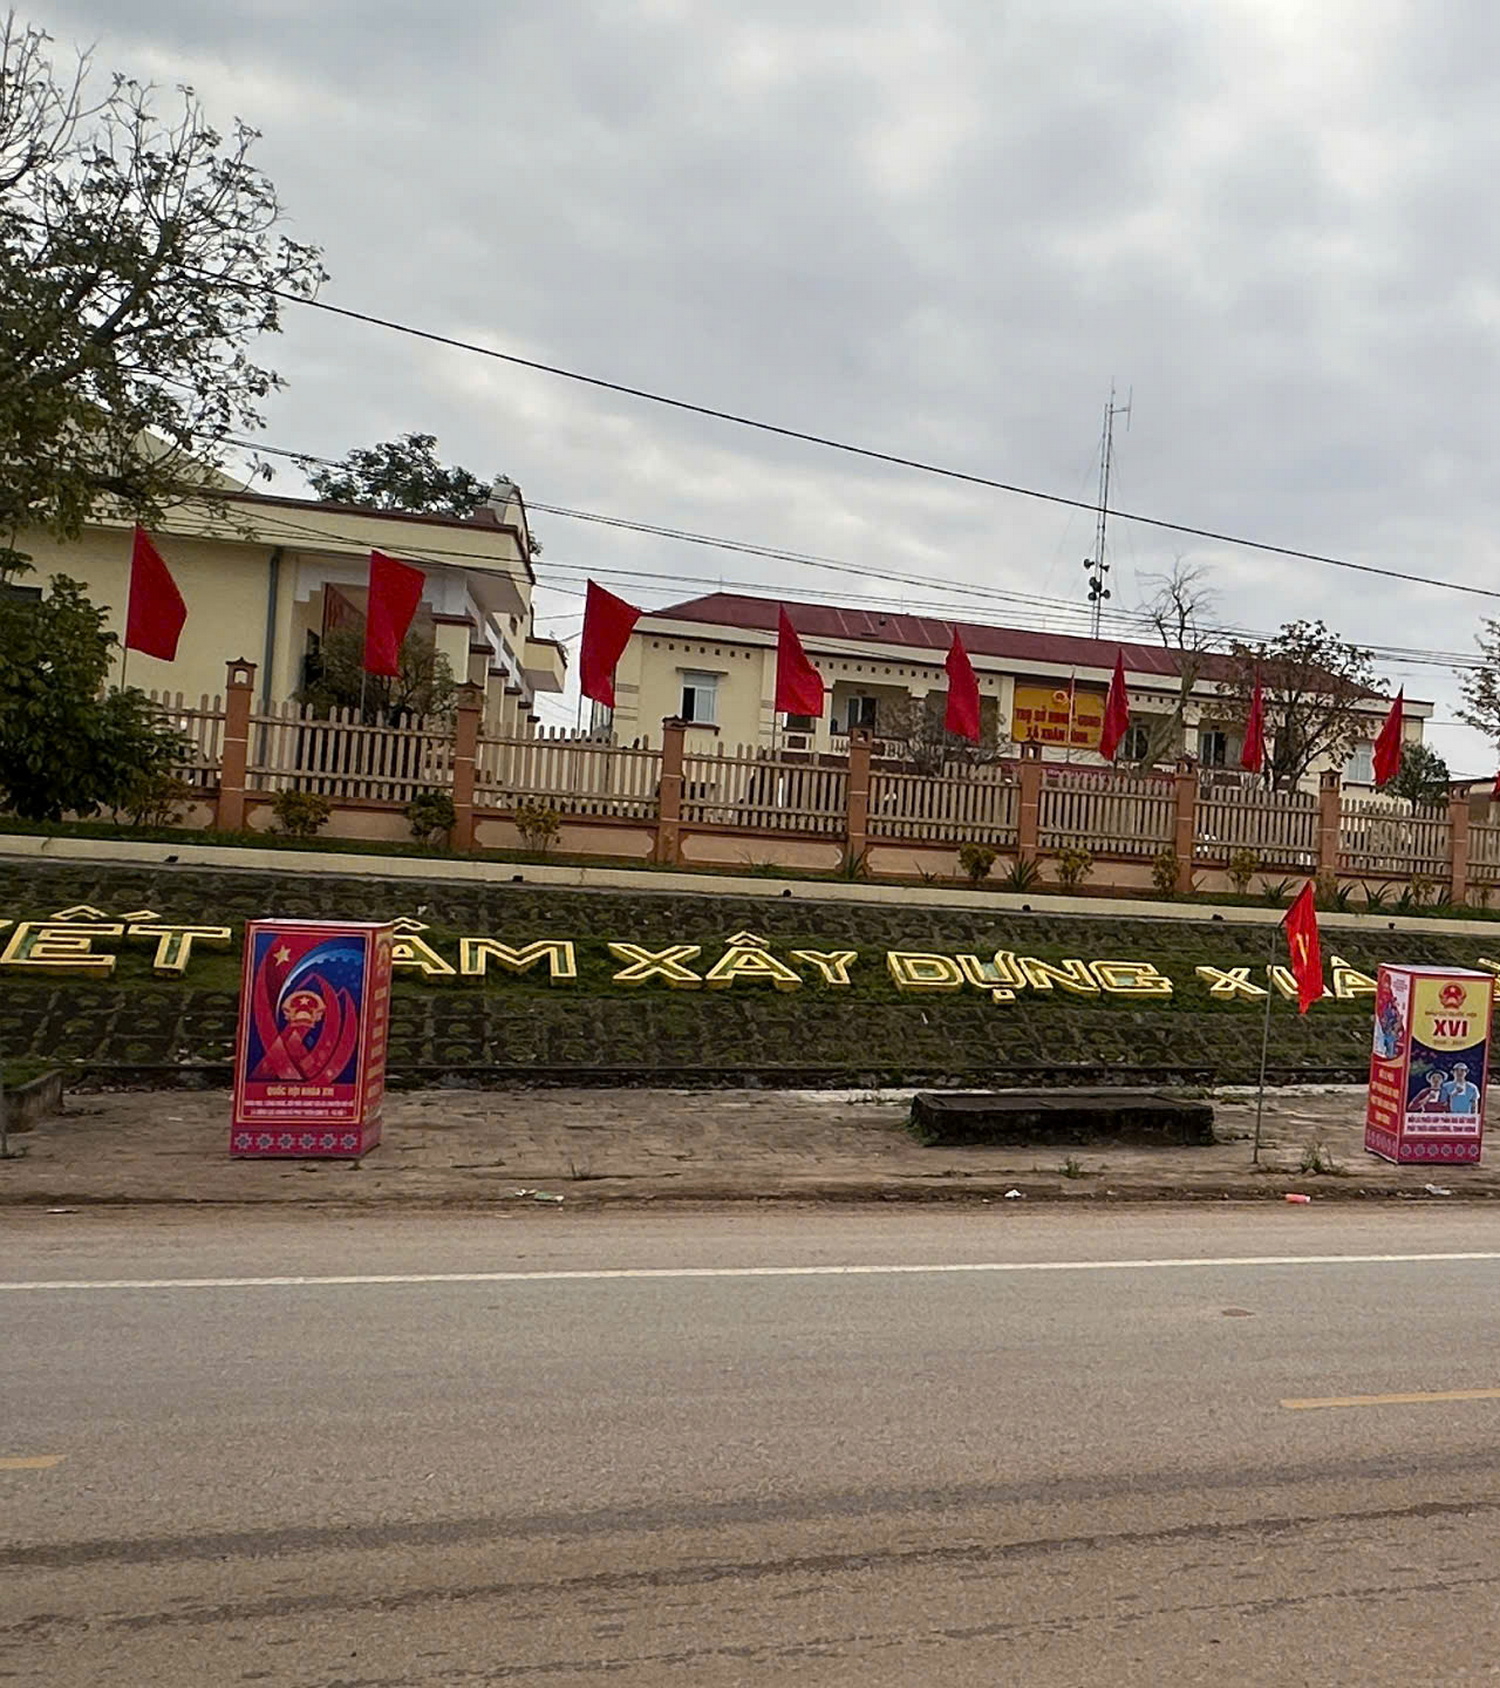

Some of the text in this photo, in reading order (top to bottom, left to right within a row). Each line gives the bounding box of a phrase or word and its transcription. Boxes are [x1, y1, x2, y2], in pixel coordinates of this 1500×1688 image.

[0, 905, 232, 977] ẾT
[392, 917, 579, 985] ÂM
[607, 931, 858, 988] XÂY
[887, 950, 1174, 1005] DỰNG
[1433, 1019, 1467, 1037] XVI
